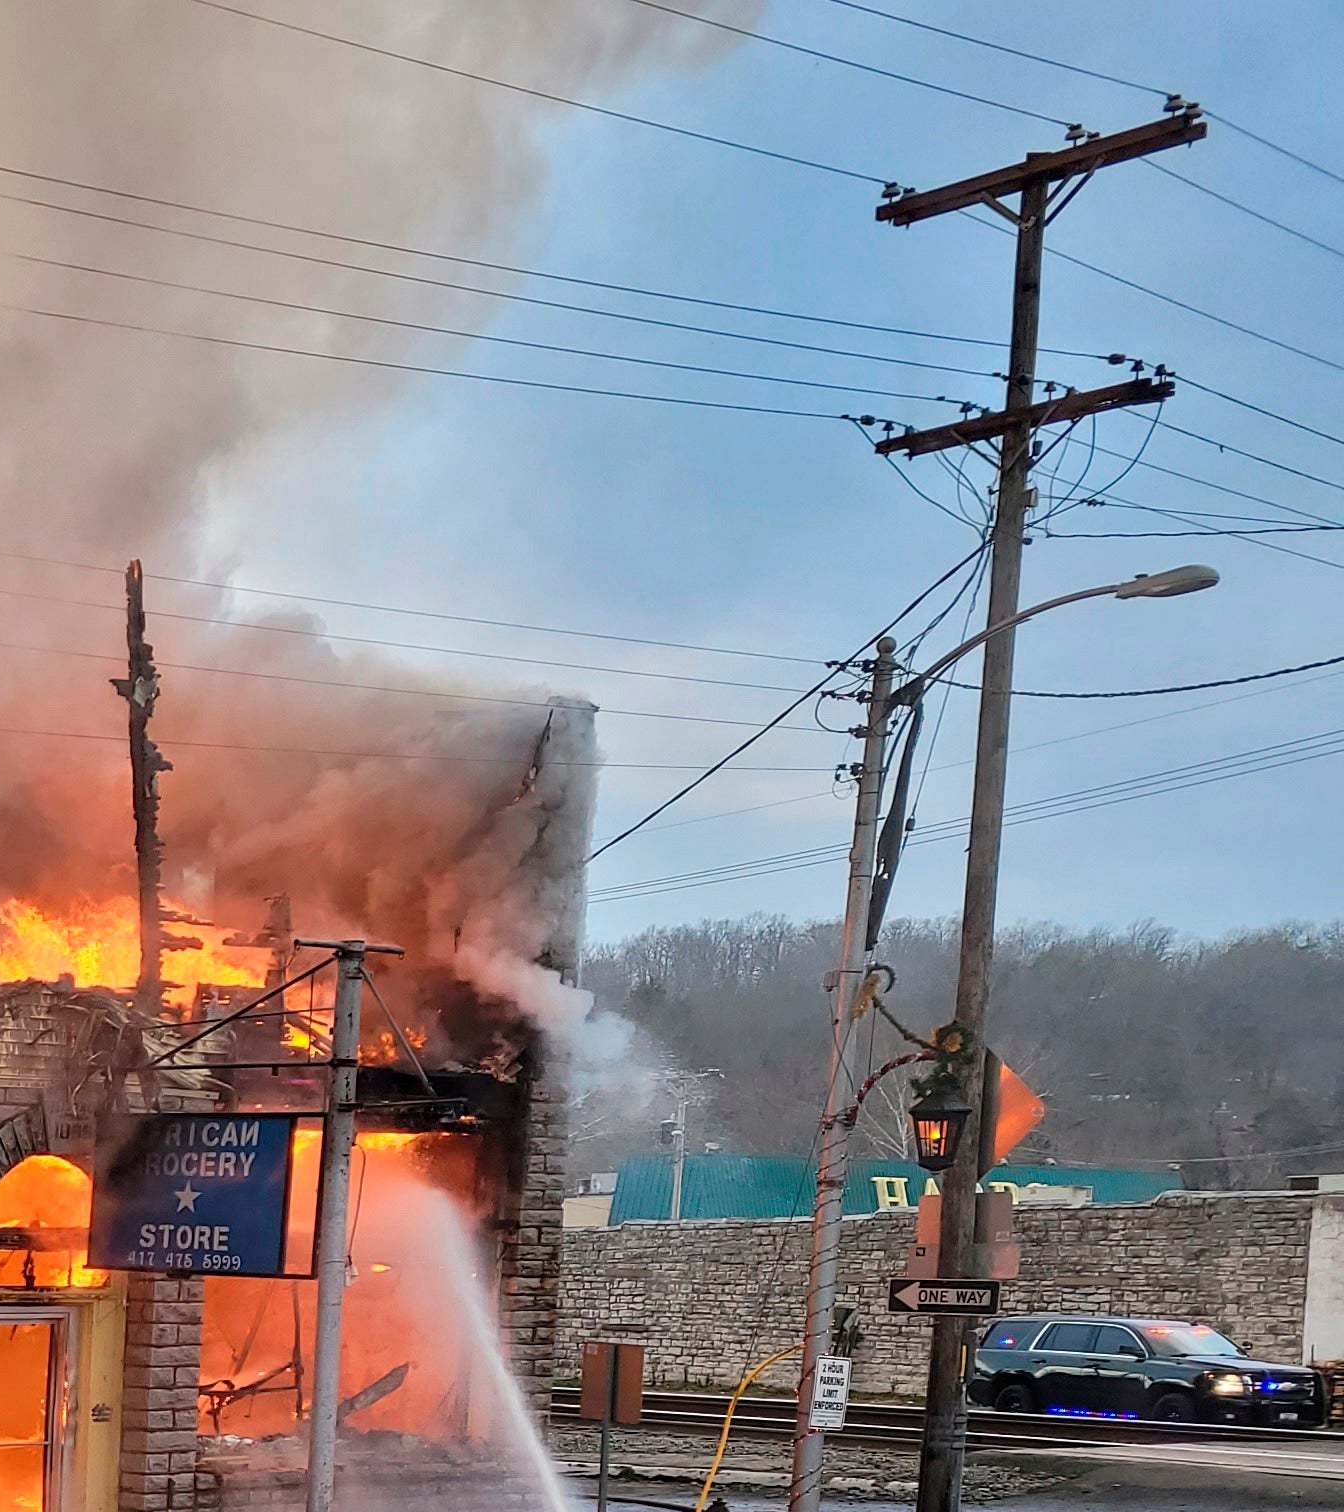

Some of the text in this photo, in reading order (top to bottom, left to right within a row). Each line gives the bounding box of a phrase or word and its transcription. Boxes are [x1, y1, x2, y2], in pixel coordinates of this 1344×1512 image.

[150, 1121, 260, 1148] RICAN
[144, 1151, 256, 1177] ROCERY
[139, 1223, 230, 1251] STORE
[128, 1250, 242, 1271] 417 475 5999
[918, 1289, 987, 1304] ONE WAY
[822, 1363, 844, 1374] 2 HOUR
[819, 1376, 845, 1387] PARKING
[822, 1388, 839, 1398] LIMIT
[814, 1400, 843, 1411] ENFORCED
